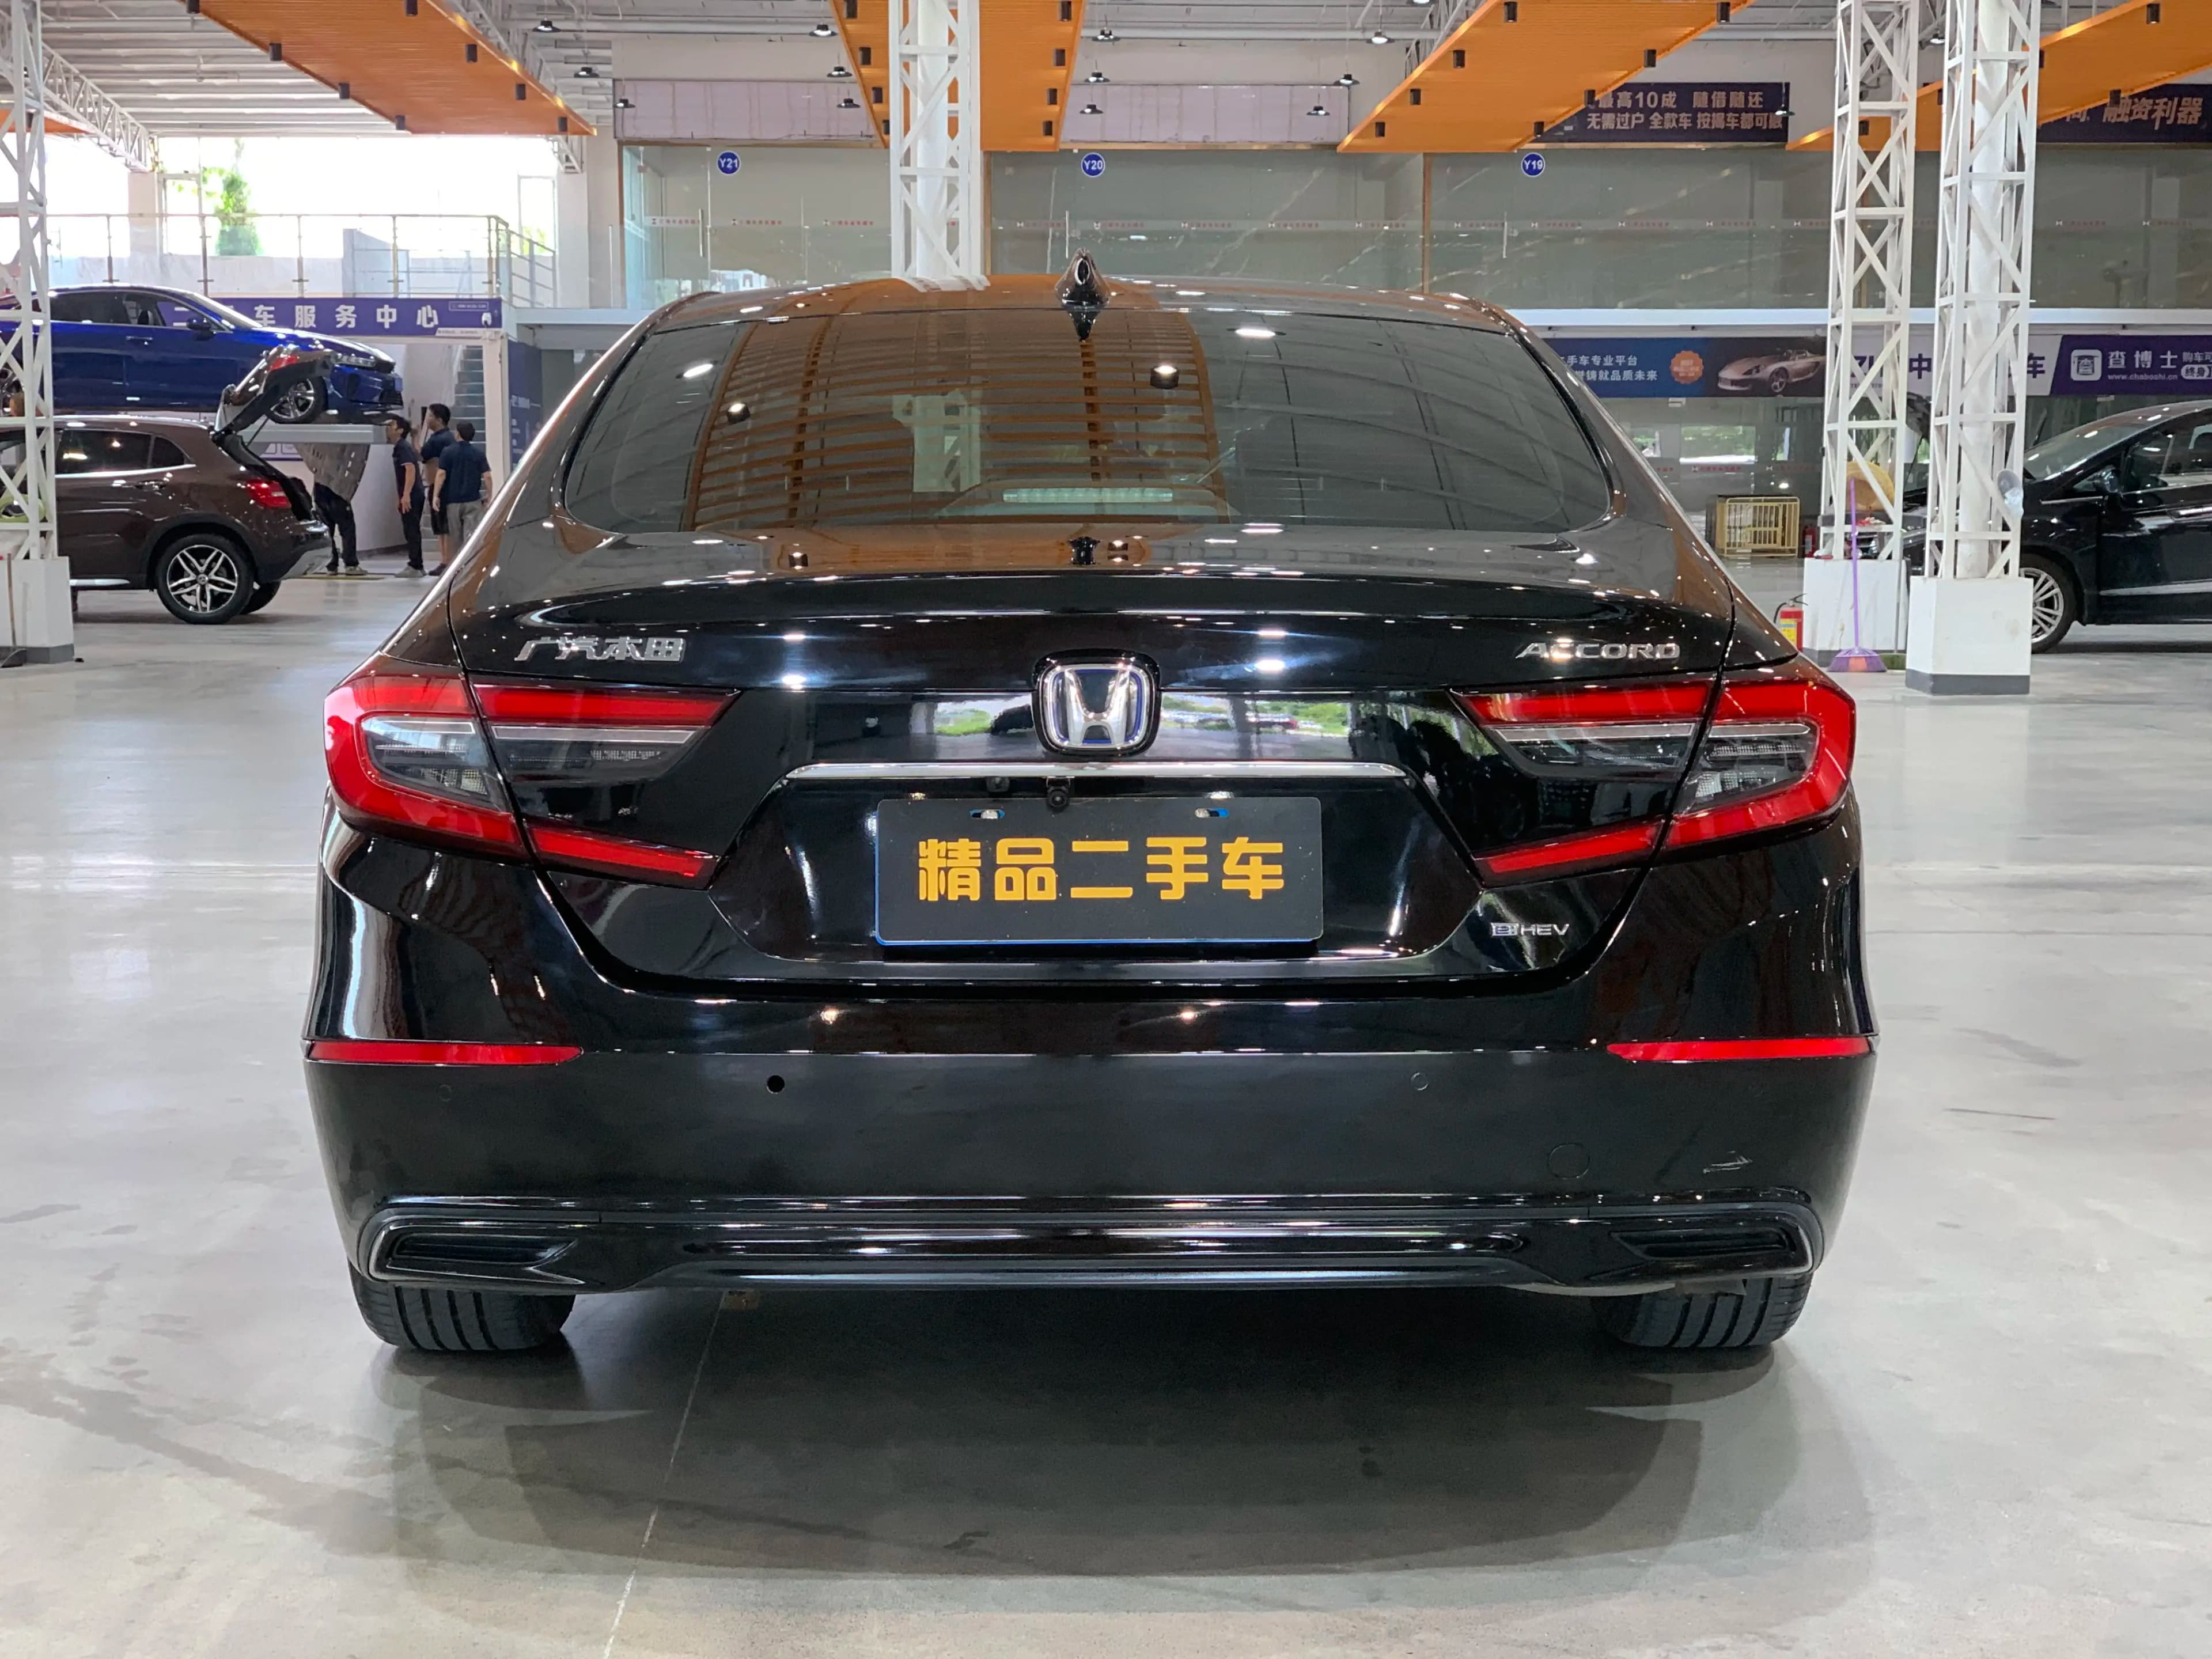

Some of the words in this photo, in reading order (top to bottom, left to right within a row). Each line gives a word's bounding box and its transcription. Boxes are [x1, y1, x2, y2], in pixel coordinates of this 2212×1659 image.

[1587, 112, 1645, 129] 无需过户
[719, 158, 738, 168] Y21
[1084, 160, 1103, 170] Y20
[1524, 160, 1543, 170] Y19
[1560, 355, 1638, 366] 手车专业平台
[2107, 350, 2179, 369] 查博士
[514, 637, 685, 662] 广汽本田
[1515, 642, 1680, 660] ACCORD
[919, 837, 1285, 902] 精品二手车
